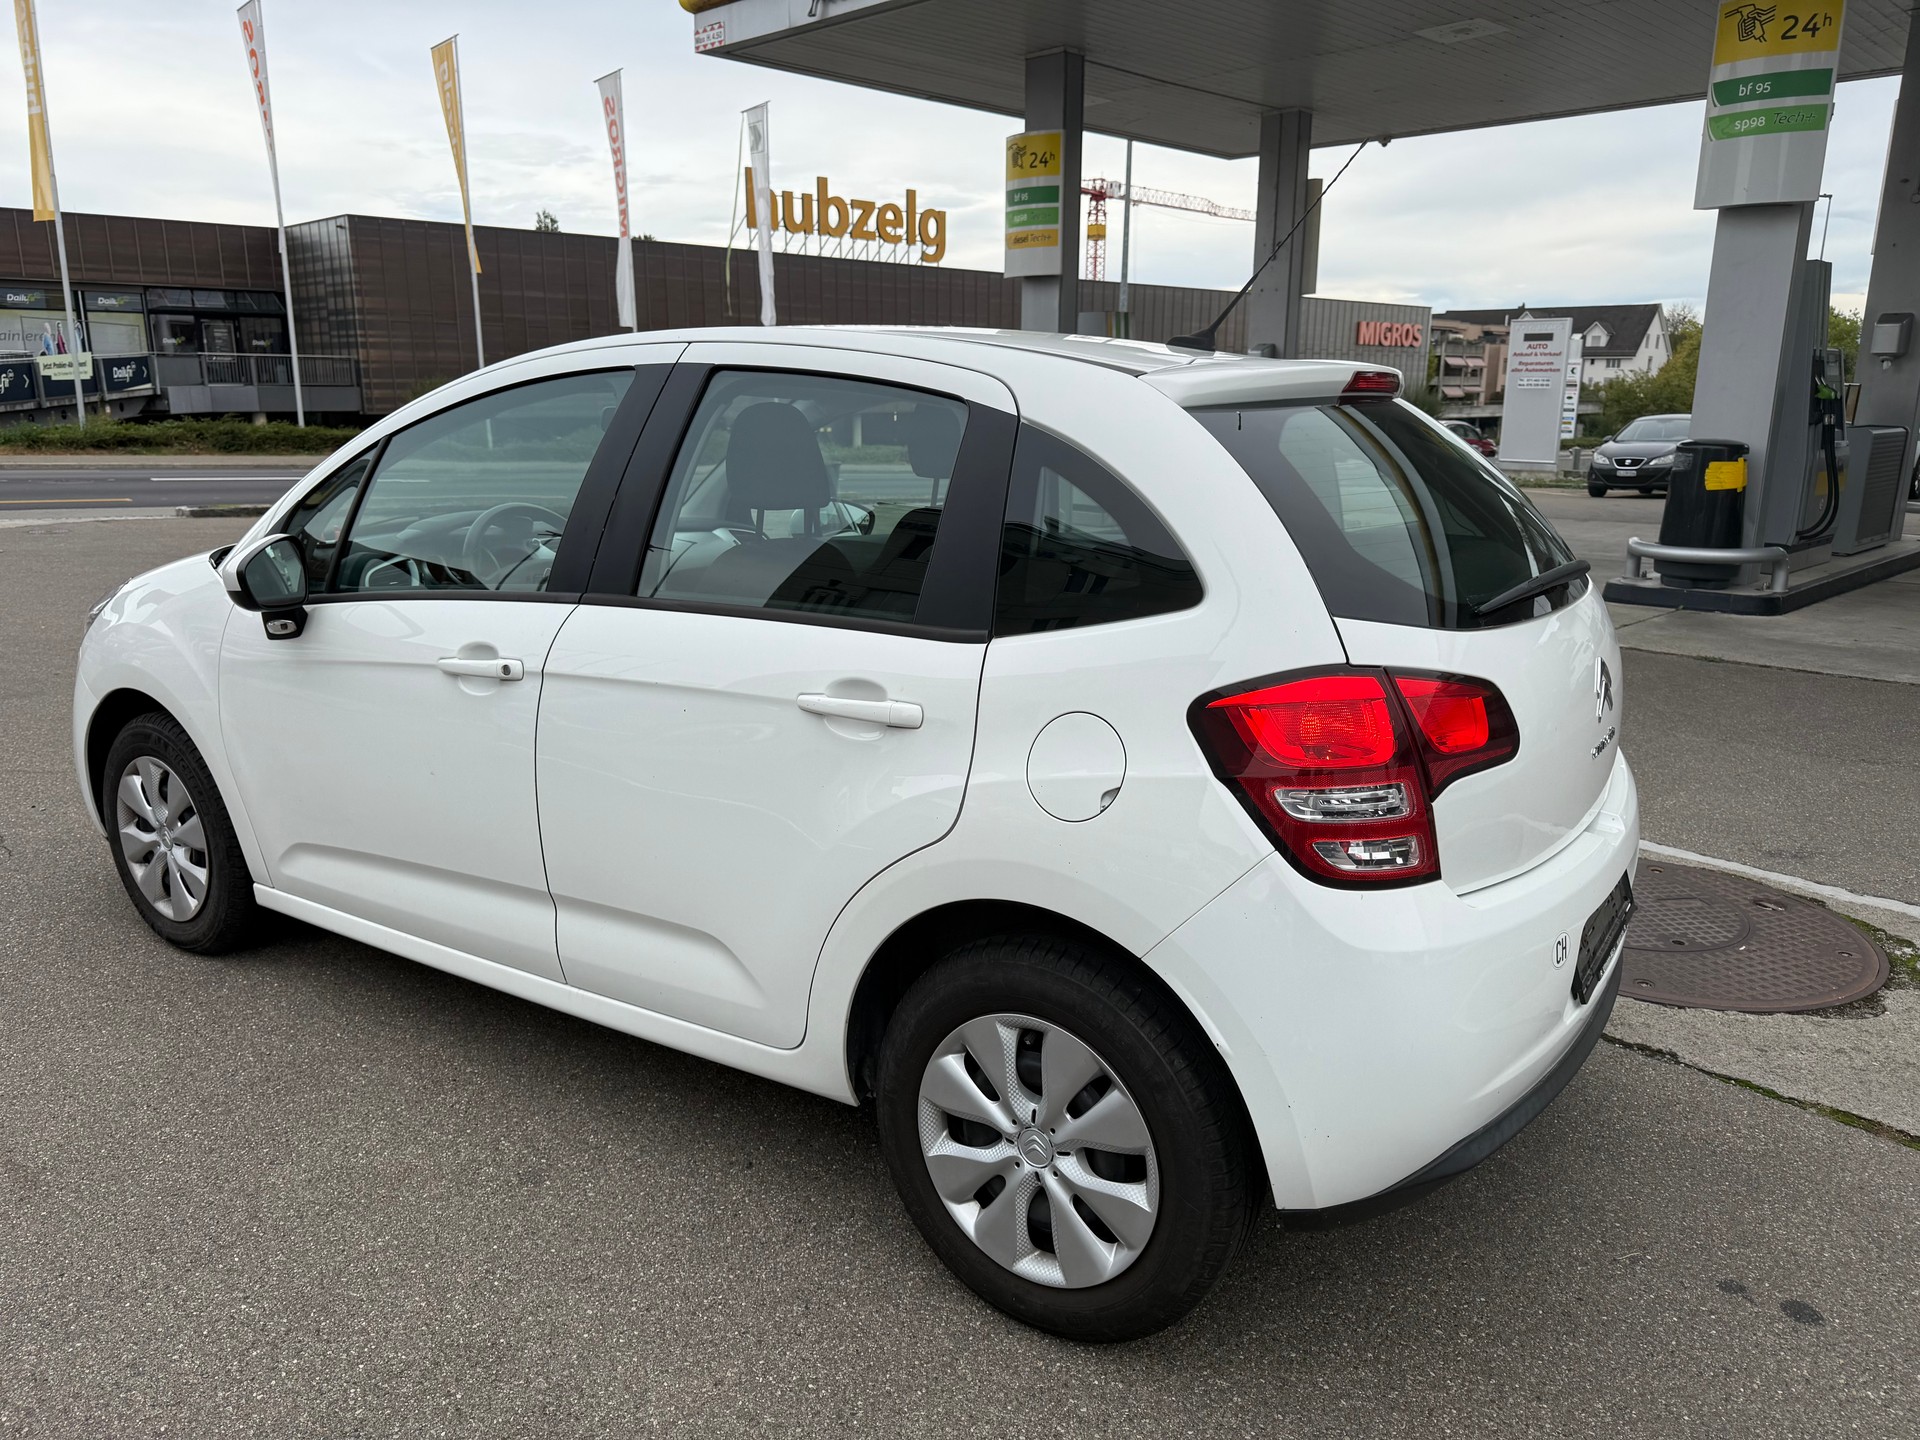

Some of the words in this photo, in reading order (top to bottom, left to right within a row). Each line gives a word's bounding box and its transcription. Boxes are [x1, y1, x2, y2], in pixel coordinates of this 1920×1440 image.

[1780, 12, 1833, 41] 24h
[1738, 84, 1753, 97] bf
[1755, 82, 1772, 94] 95
[1734, 116, 1766, 132] sp98
[1773, 111, 1816, 125] Tech+
[1029, 151, 1056, 169] 24h
[745, 166, 946, 263] hubzelg
[1357, 320, 1423, 348] MIGROS
[1556, 935, 1567, 965] CH
